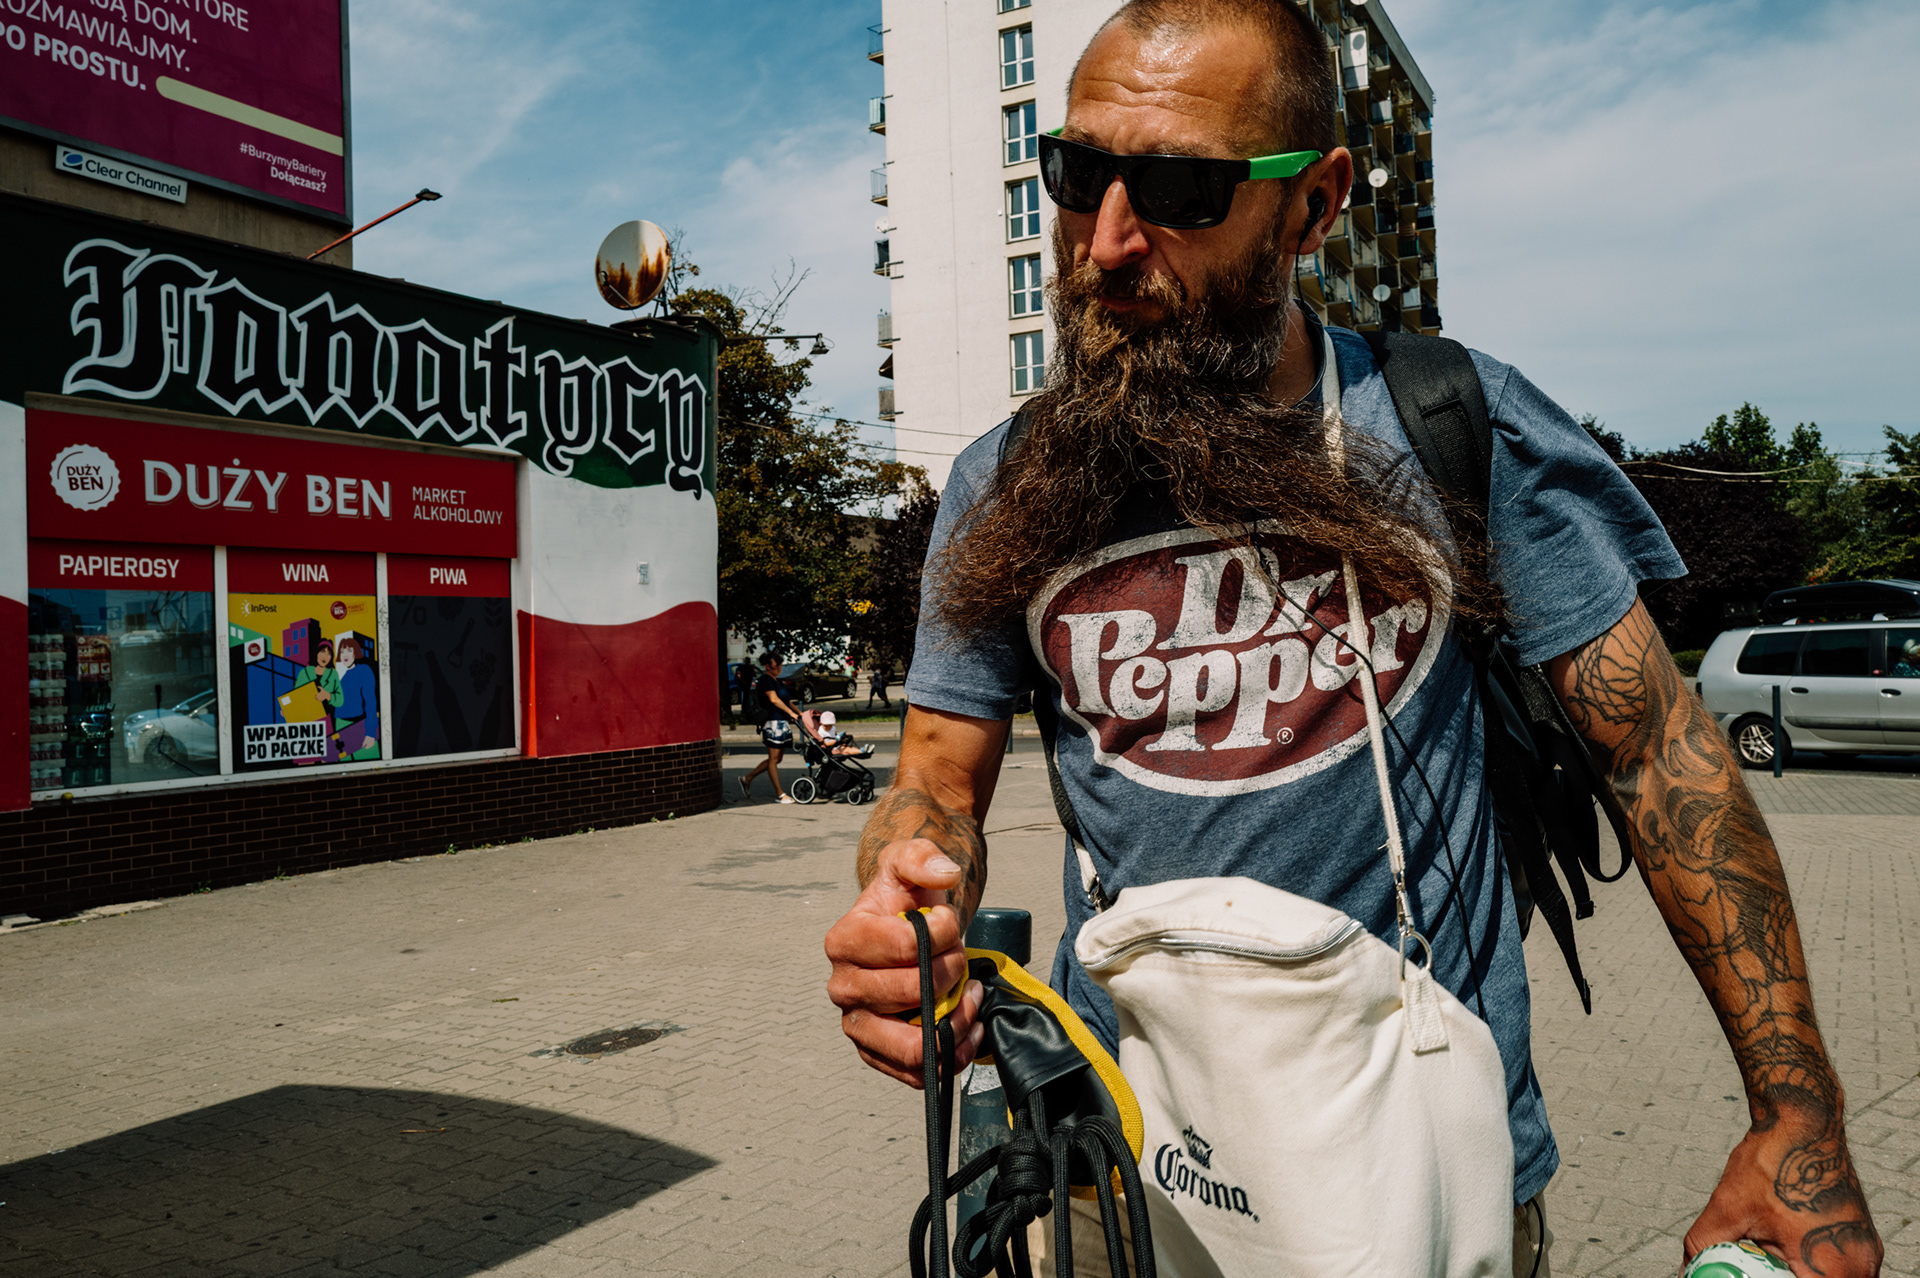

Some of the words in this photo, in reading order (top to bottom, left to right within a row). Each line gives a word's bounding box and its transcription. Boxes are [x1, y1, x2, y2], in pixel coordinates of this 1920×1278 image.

[134, 0, 198, 44] DOM.
[0, 0, 191, 72] OZMAWIAJMY.
[34, 33, 147, 91] PROSTU.
[240, 142, 327, 181] #BurzymyBariery
[85, 159, 124, 180] Clear
[125, 171, 182, 197] Channel
[270, 165, 327, 193] Dołączasz?
[66, 463, 101, 476] DUŻY
[68, 476, 104, 491] BEN
[143, 458, 289, 513] DUŻY
[305, 474, 392, 521] BEN
[412, 486, 467, 506] MARKET
[413, 505, 503, 526] ALKOHOLOWY
[59, 554, 180, 579] PAPIEROSY
[282, 562, 329, 583] WINA
[429, 566, 468, 586] PIWA
[251, 604, 277, 613] InPost
[1156, 545, 1339, 651] Dr
[1057, 598, 1427, 752] Pepper
[246, 723, 324, 742] WPADNIJ
[247, 743, 267, 760] PO
[271, 739, 325, 757] PACZKĘ
[1155, 1143, 1253, 1215] Corona
